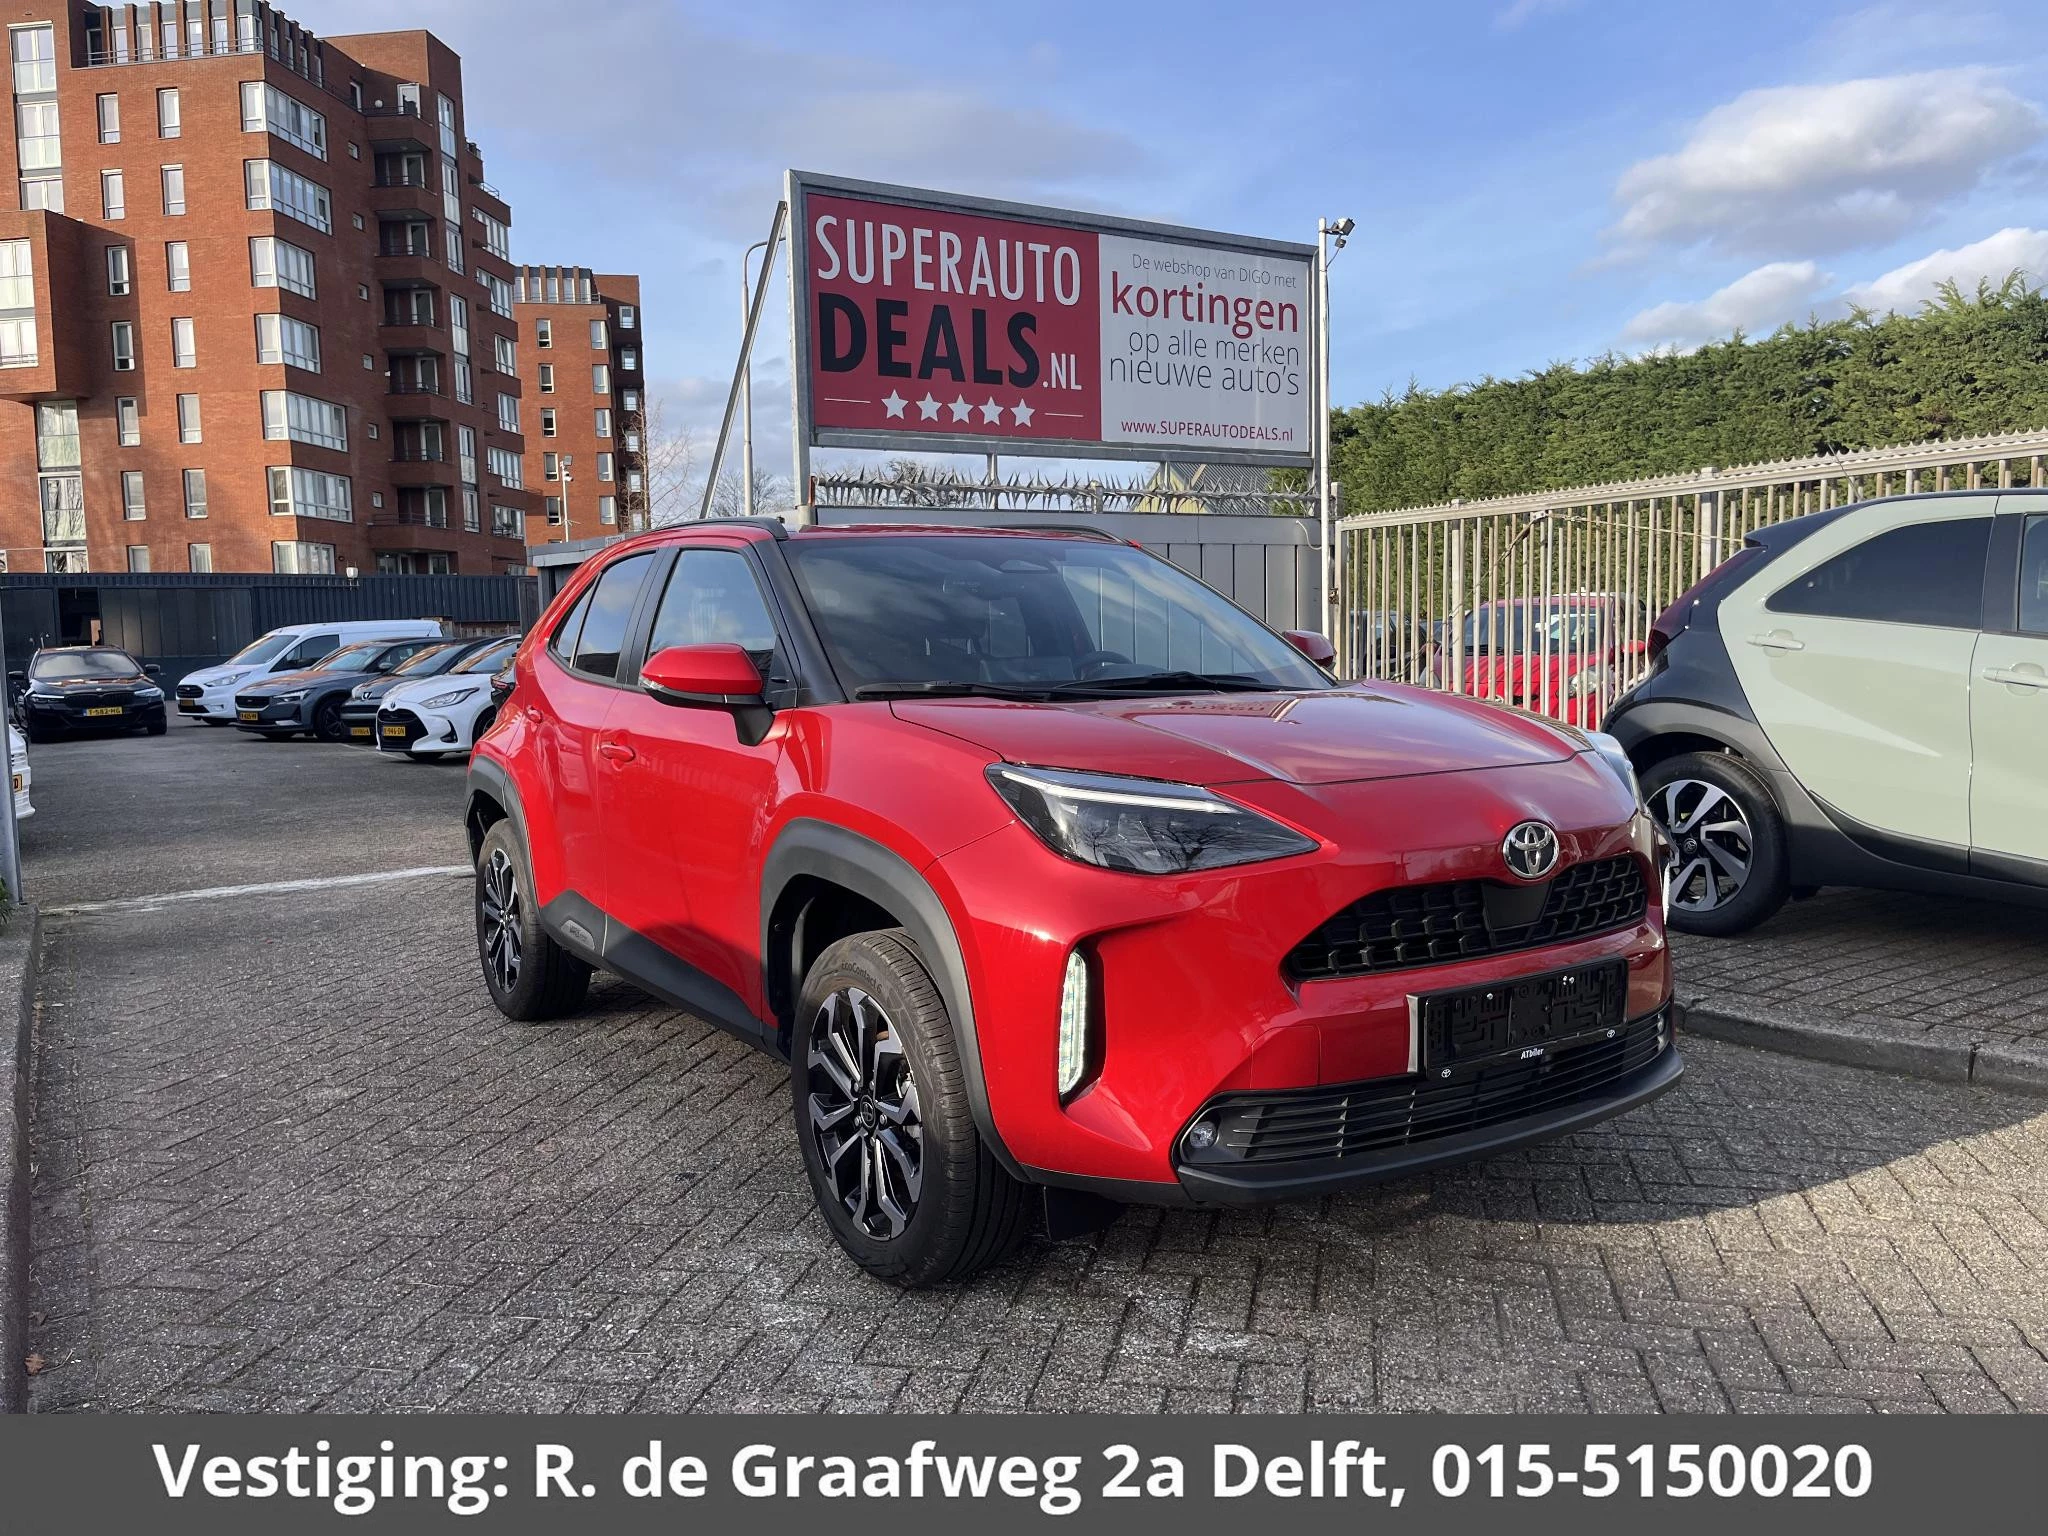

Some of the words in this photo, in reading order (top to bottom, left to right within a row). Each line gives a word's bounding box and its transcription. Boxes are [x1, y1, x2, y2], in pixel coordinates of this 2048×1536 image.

[815, 215, 1081, 306] SUPERAUTO
[1132, 253, 1150, 270] De
[1154, 258, 1211, 280] webshop
[1214, 266, 1235, 281] van
[1239, 267, 1271, 285] DIGO
[1274, 274, 1297, 289] met
[1111, 270, 1298, 340] kortingen
[1129, 331, 1160, 361] op
[1168, 329, 1207, 358] alle
[1216, 336, 1300, 367] merken
[1110, 352, 1212, 389] nieuwe
[1221, 365, 1300, 396] auto's
[1120, 420, 1294, 442] www.SUPERAUTODEALS.nl
